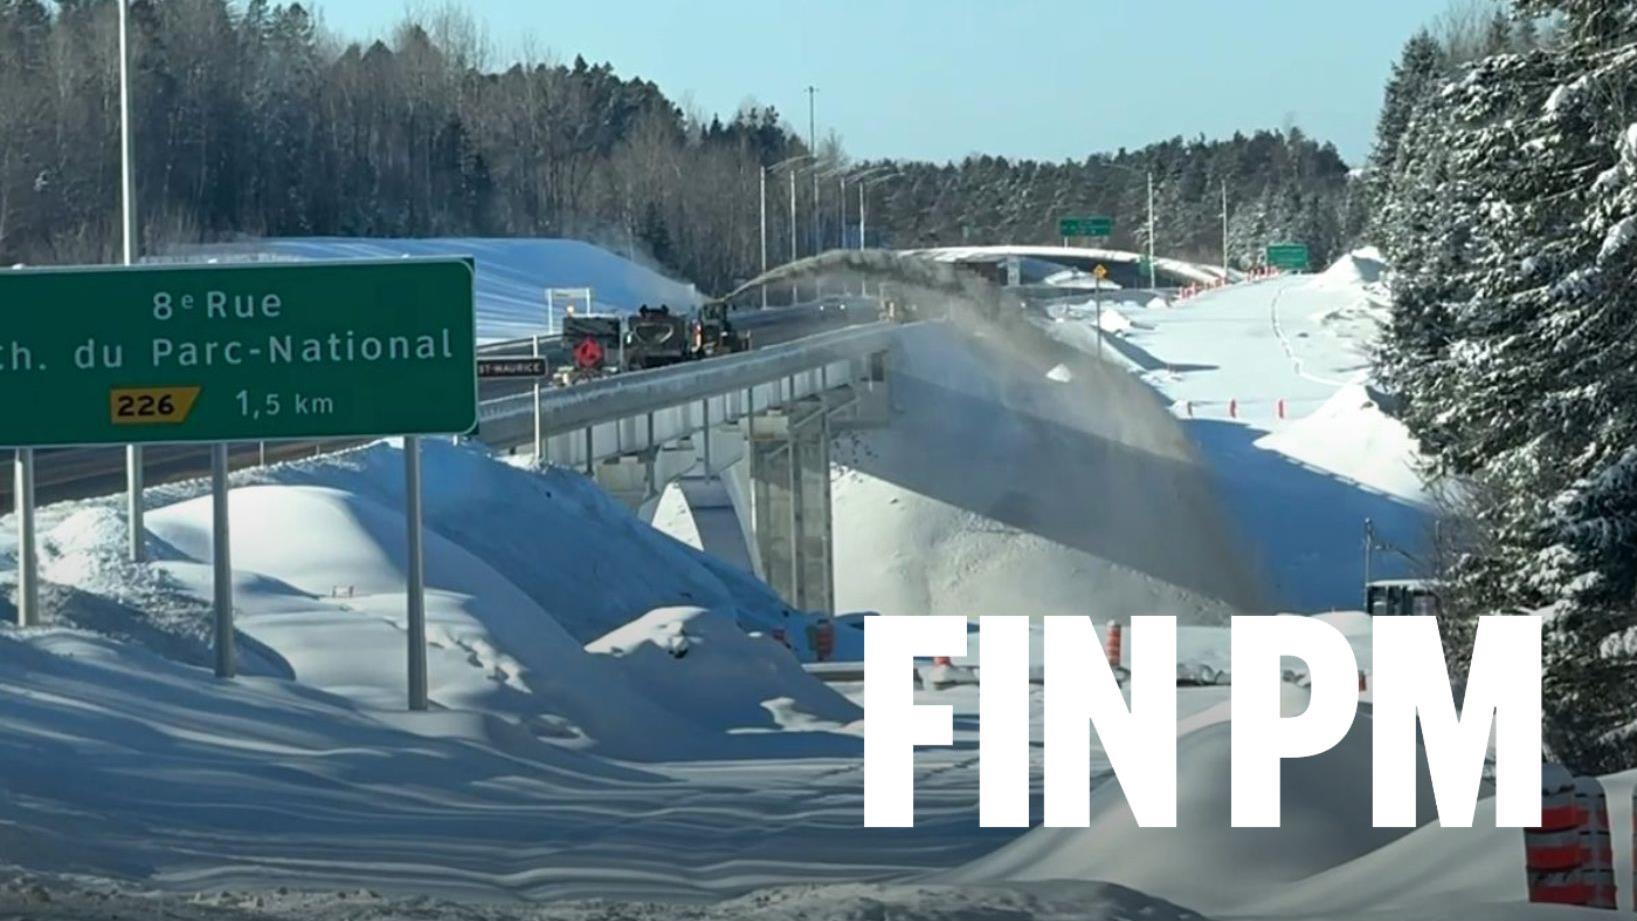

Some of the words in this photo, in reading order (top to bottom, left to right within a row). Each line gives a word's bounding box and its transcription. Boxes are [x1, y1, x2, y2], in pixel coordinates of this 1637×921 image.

[206, 290, 281, 318] Rue
[0, 340, 47, 371] h.
[74, 338, 123, 369] du
[153, 328, 453, 367] Parc-National
[117, 394, 176, 417] 226
[236, 389, 280, 419] 1,5
[295, 393, 334, 414] km
